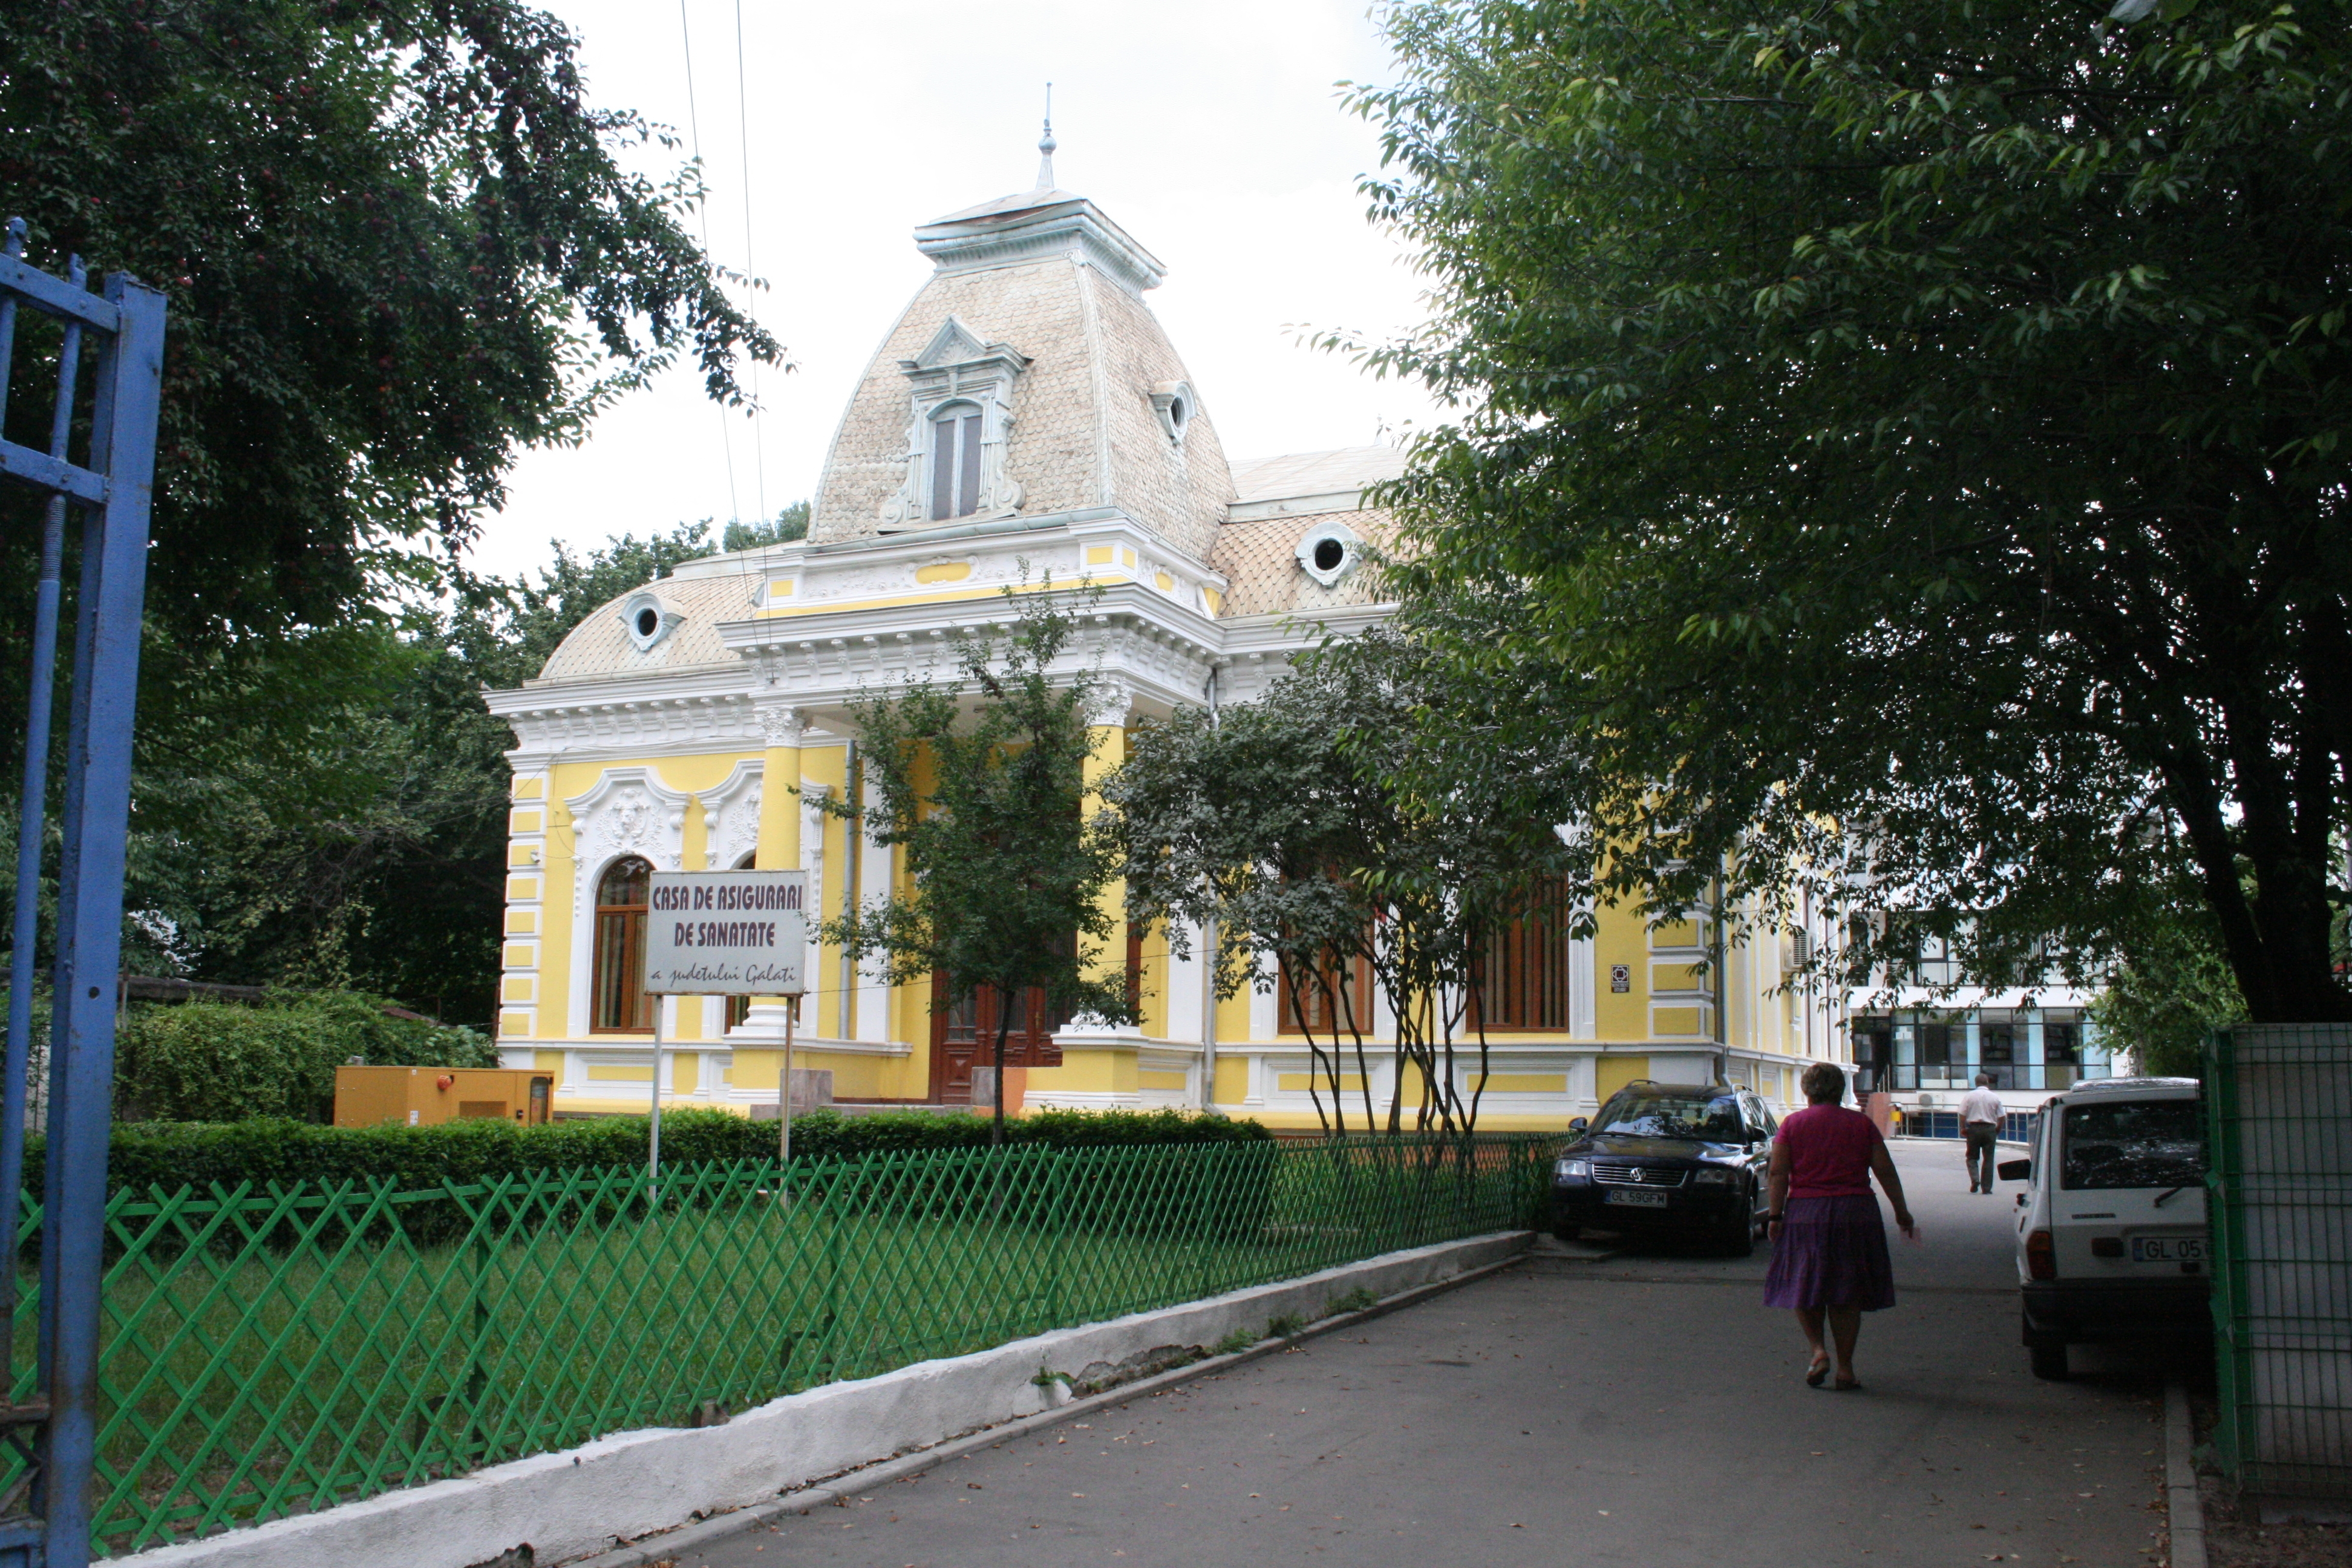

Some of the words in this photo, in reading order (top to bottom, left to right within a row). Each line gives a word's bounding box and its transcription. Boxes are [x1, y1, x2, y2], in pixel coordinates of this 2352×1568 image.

[653, 886, 689, 910] CASA
[694, 886, 713, 910] DE
[717, 884, 802, 910] ASIGURARI
[675, 923, 694, 947] DE
[697, 922, 775, 947] SANATATE
[651, 970, 662, 980] a
[670, 962, 740, 987] judetului
[746, 963, 796, 986] Galati
[1612, 1191, 1625, 1202] GL
[2146, 1240, 2172, 1258] GL
[2178, 1240, 2201, 1258] 05
